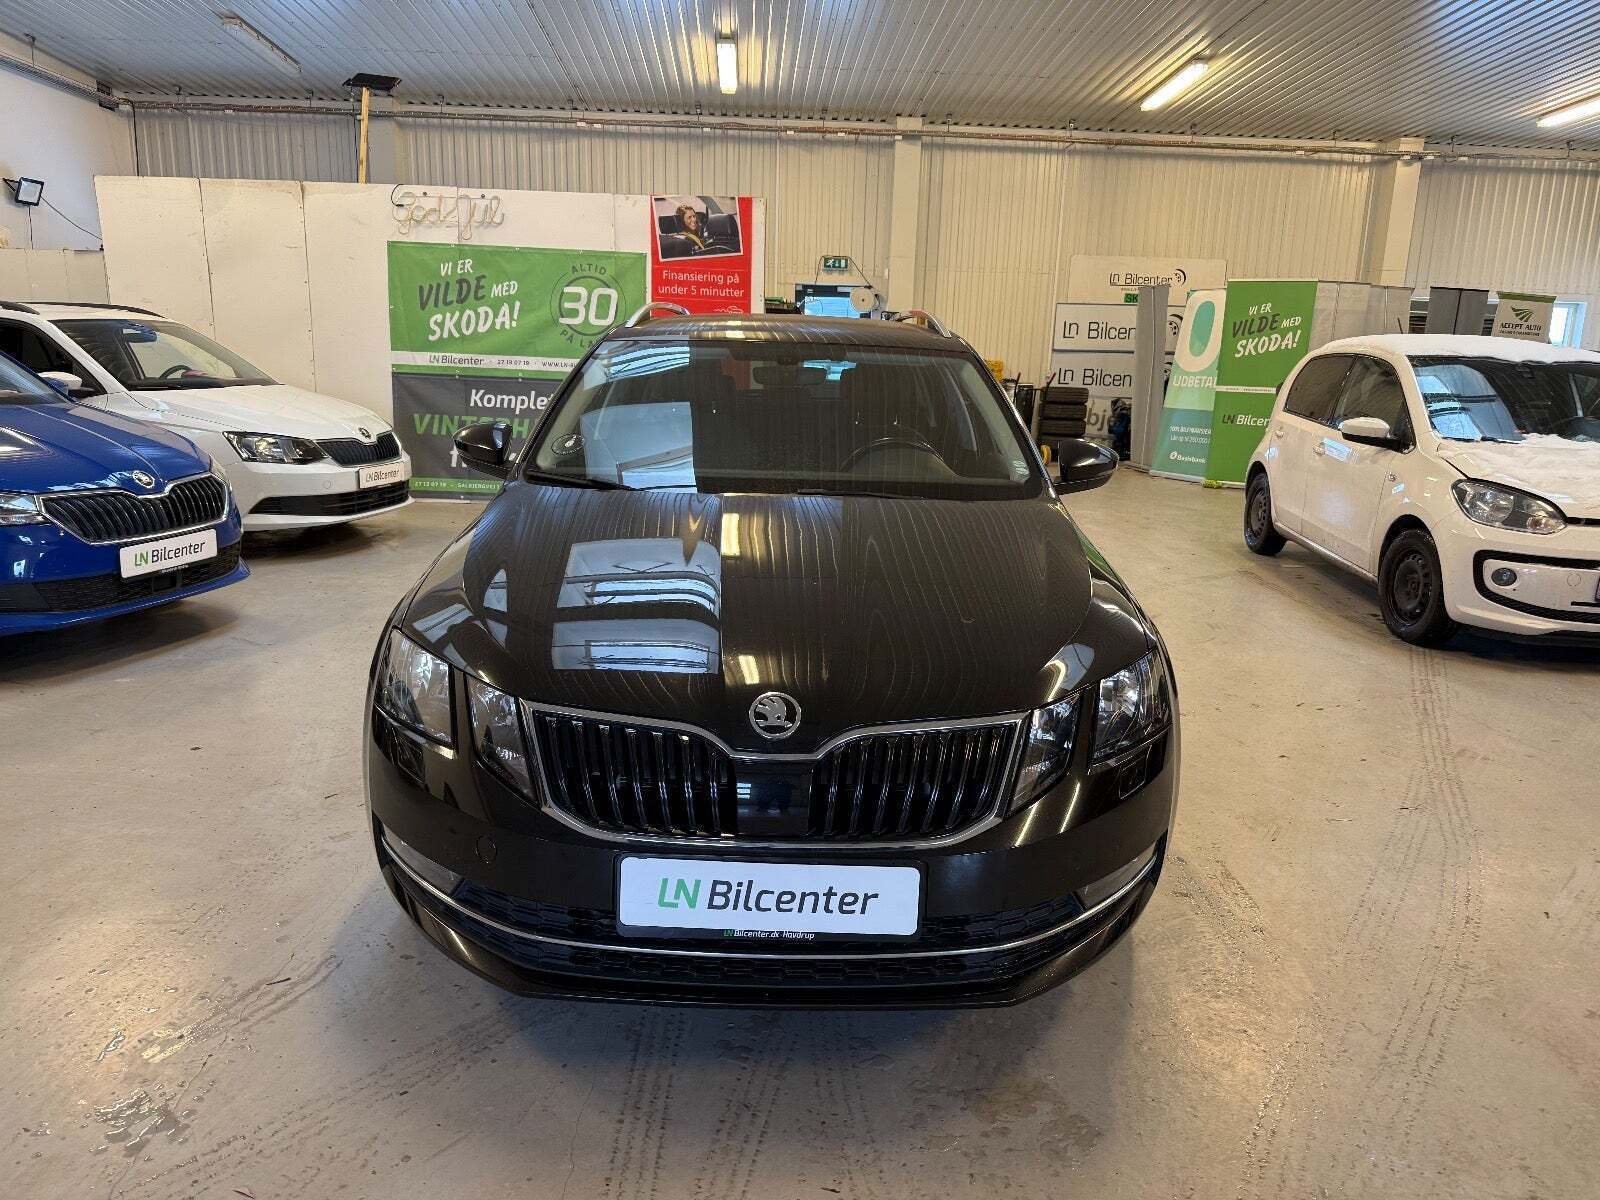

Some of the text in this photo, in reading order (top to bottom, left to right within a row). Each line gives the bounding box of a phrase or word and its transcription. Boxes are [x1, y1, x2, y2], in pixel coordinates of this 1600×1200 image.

[440, 258, 474, 277] VI ER
[571, 263, 607, 276] ALTID
[662, 270, 740, 286] Finansiering på
[1124, 273, 1173, 286] Bilcenter
[418, 274, 519, 312] VILDE MED
[658, 284, 745, 298] under 5 minutter
[559, 286, 619, 327] 30
[1249, 302, 1272, 316] VI ER
[428, 300, 521, 342] SKODA!
[1232, 313, 1302, 338] VILDE MED
[1234, 329, 1302, 358] SKODA!
[441, 355, 485, 366] Bilcenter
[470, 389, 554, 414] Komple
[374, 469, 400, 481] Bilcenter
[134, 541, 206, 567] LN Bilcenter
[657, 877, 879, 915] LN Bilcenter
[783, 930, 815, 940] Havdrup
